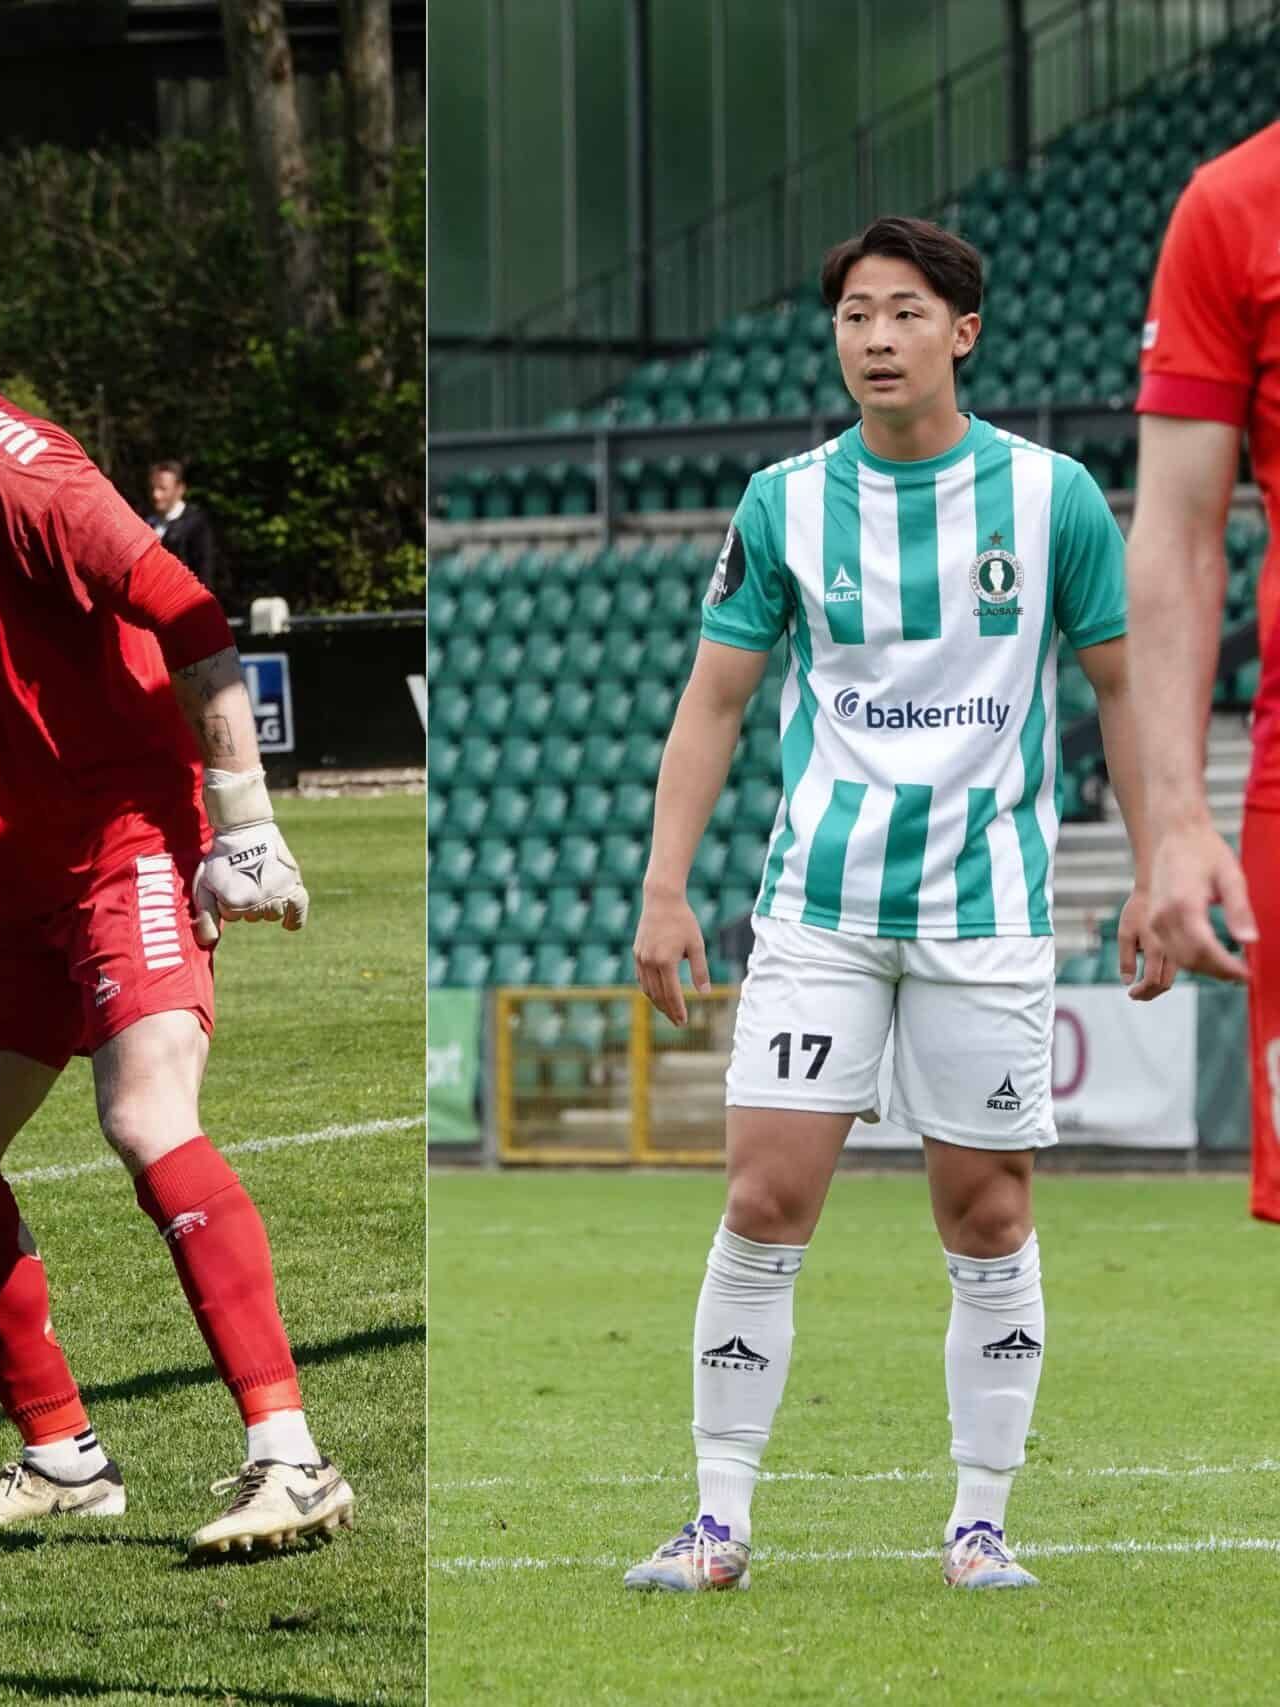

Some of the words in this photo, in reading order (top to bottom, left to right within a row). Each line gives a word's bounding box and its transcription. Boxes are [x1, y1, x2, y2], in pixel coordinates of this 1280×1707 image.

[824, 591, 861, 602] SELECT
[972, 607, 1025, 617] GLADSAXE
[866, 696, 1011, 734] bakertilly
[228, 842, 268, 867] SELECT
[768, 1031, 833, 1080] 17
[986, 1099, 1022, 1111] SELECT
[981, 1350, 1042, 1361] SELECT
[700, 1357, 769, 1372] SELECT
